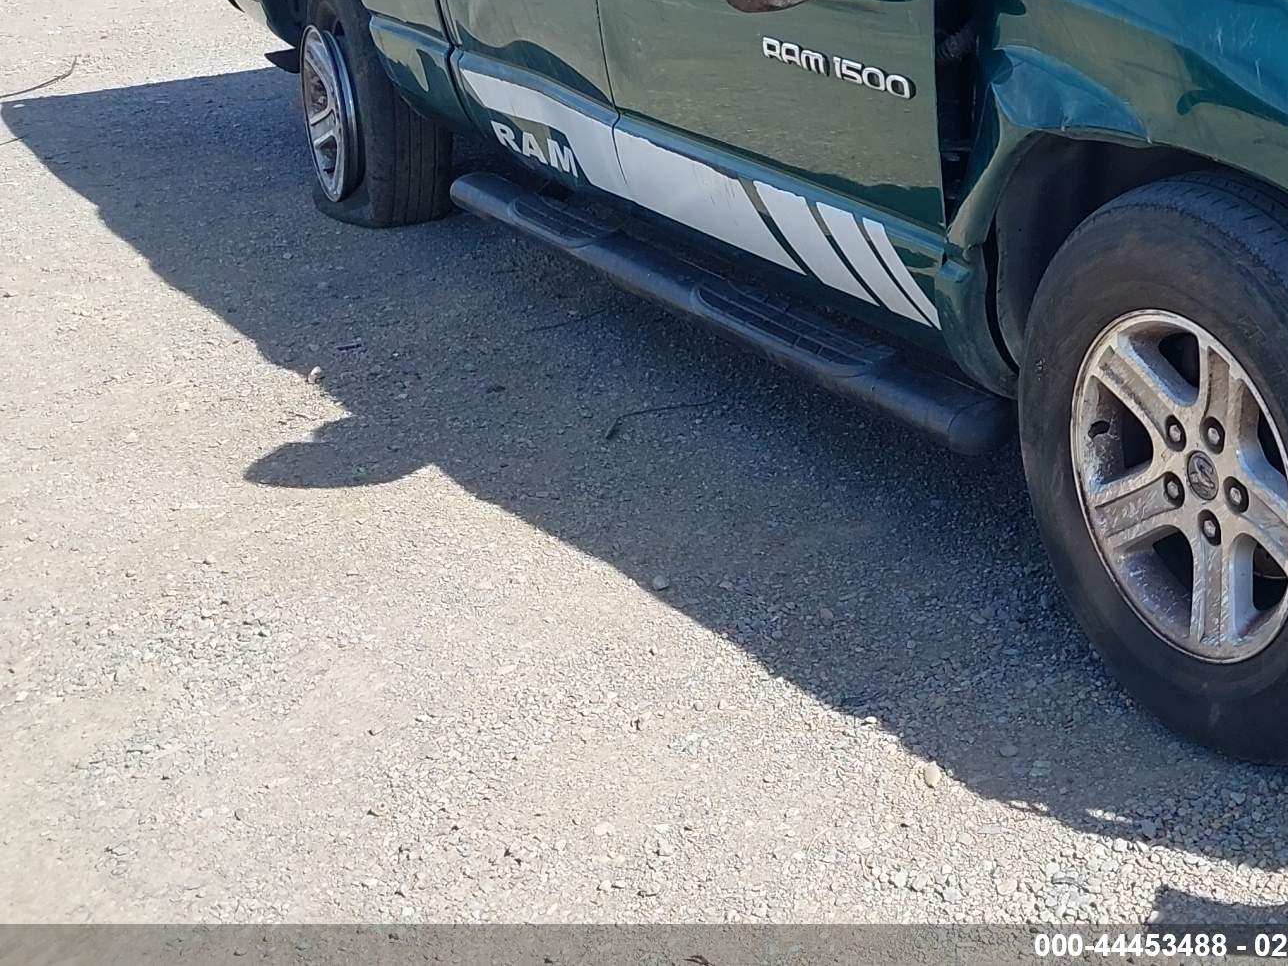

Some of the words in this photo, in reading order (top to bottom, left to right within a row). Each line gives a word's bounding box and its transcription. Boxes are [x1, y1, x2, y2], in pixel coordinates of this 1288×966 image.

[762, 36, 829, 77] RAM
[832, 56, 915, 100] 1500
[490, 120, 579, 178] RAM
